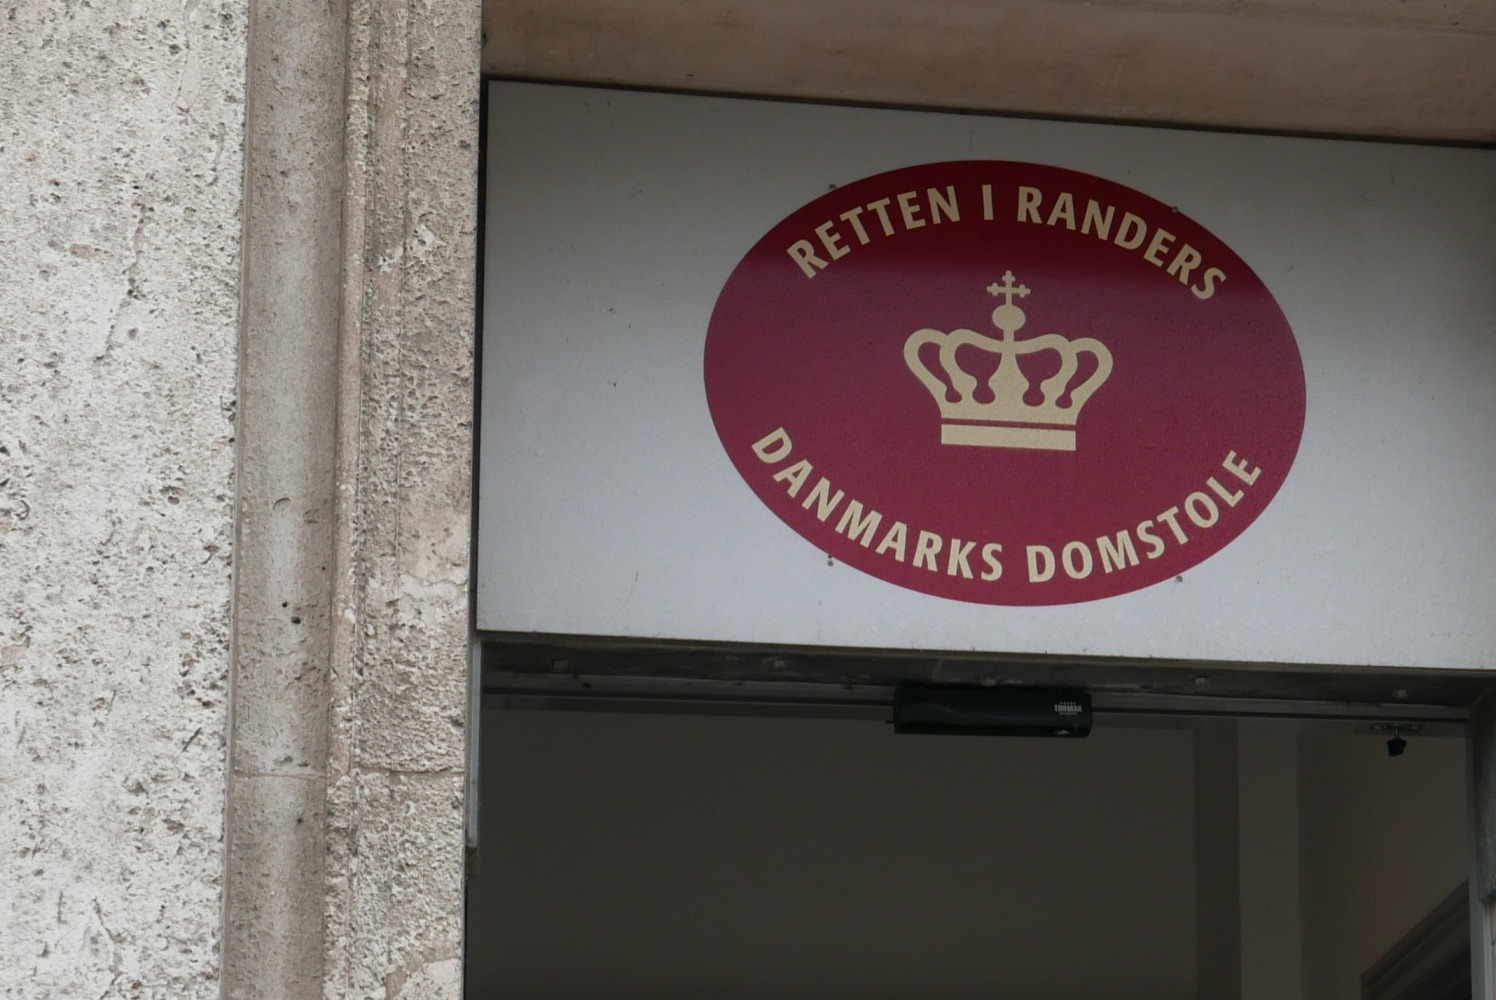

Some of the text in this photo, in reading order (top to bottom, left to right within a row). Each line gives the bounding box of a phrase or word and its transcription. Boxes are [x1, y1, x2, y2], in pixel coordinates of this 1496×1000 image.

[786, 184, 1227, 300] RETTEN I RANDERS
[751, 426, 1261, 583] DANMARKS DOMSTOLE
